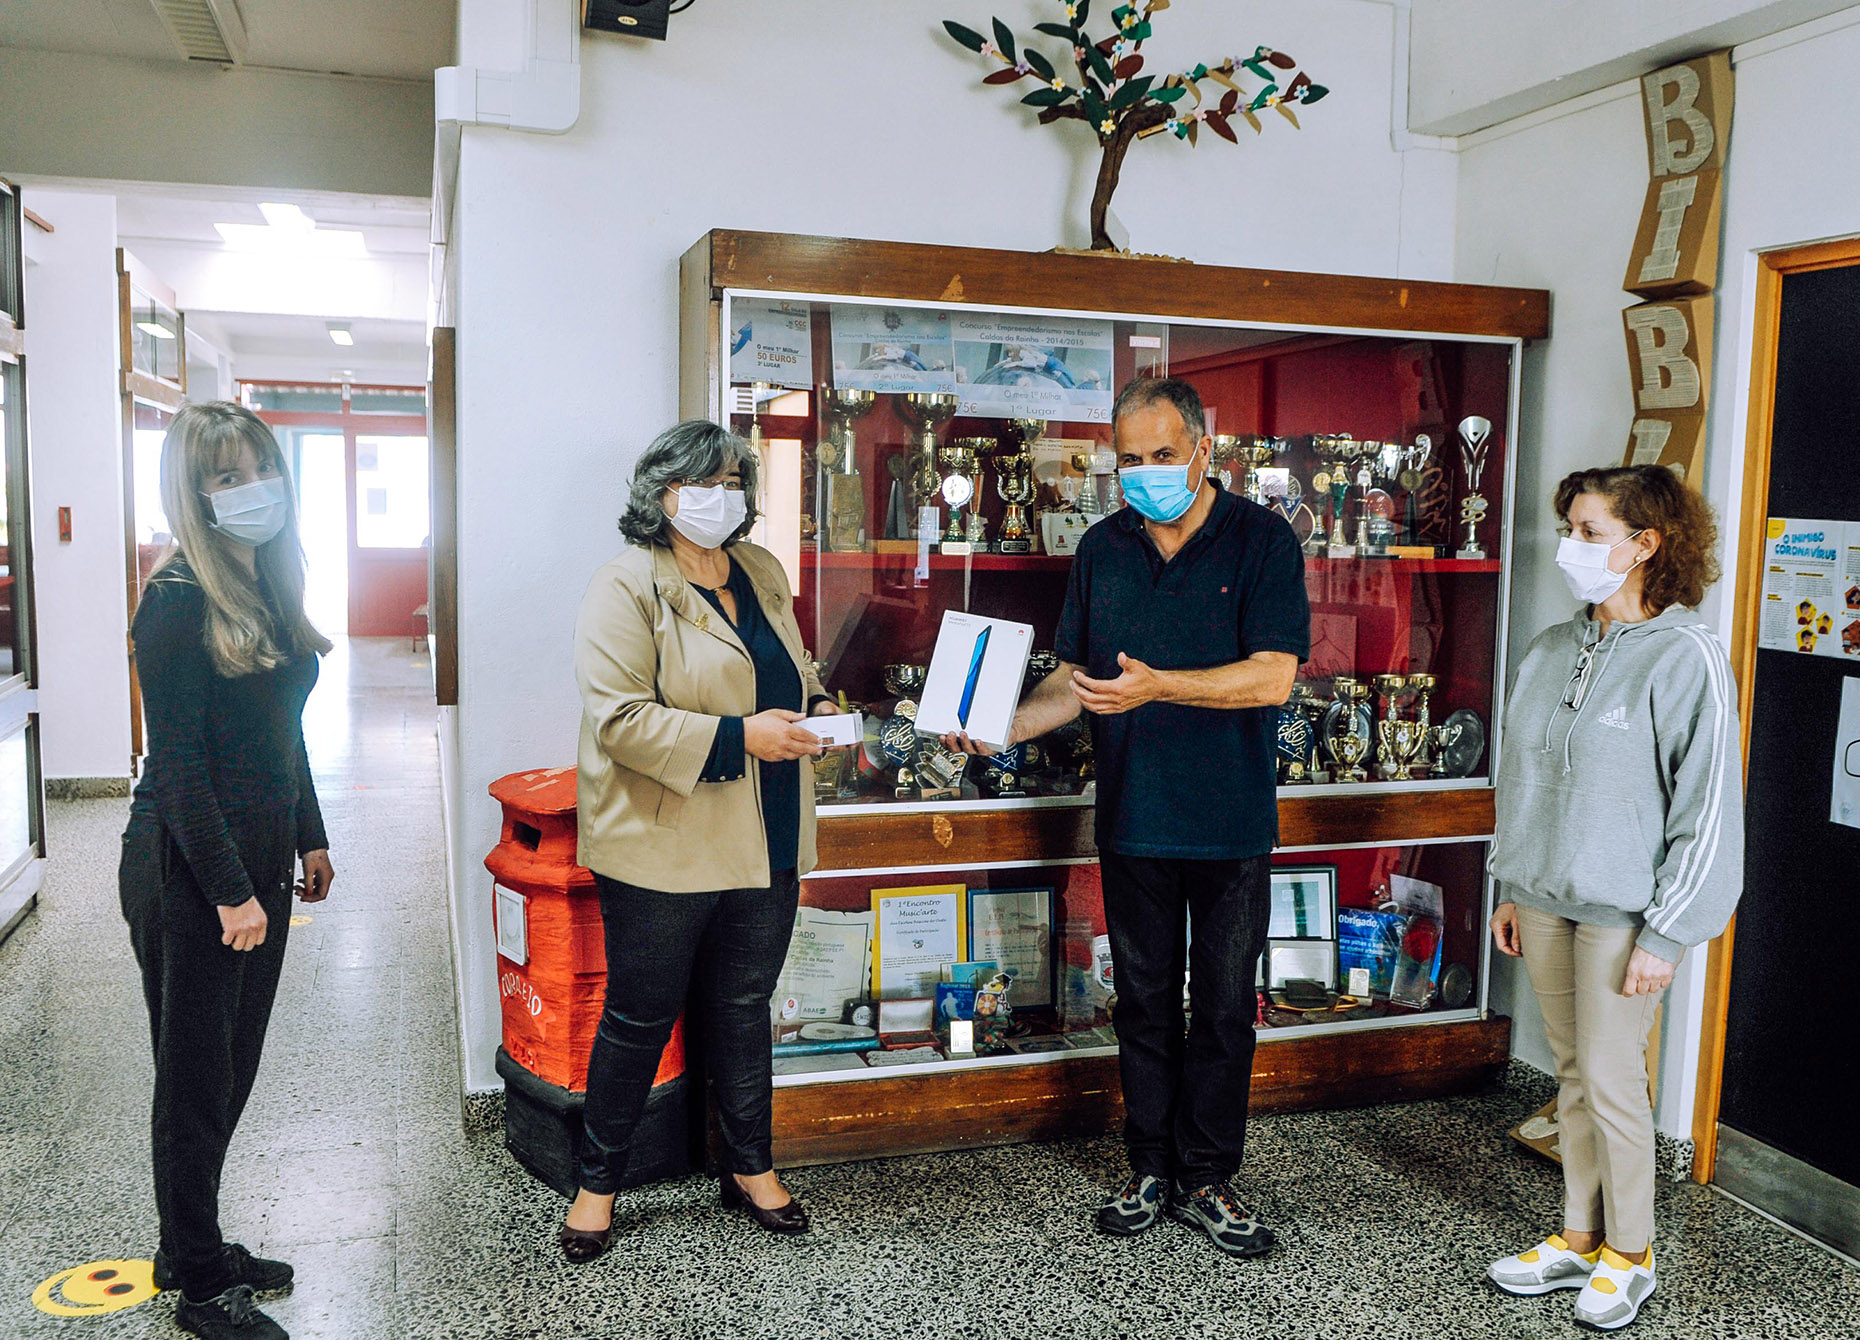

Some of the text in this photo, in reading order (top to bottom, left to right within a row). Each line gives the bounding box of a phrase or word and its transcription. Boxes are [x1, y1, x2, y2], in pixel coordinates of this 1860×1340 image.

[959, 321, 992, 330] Concurso
[980, 333, 1004, 341] Caldas
[1005, 334, 1014, 342] da
[1016, 335, 1039, 343] Rainha
[1046, 336, 1084, 346] 2014/2015
[757, 352, 797, 364] 50 EUROS
[891, 383, 914, 391] Lugar
[937, 384, 953, 392] 75€
[1003, 390, 1011, 399] O
[956, 402, 978, 414] 75€
[1026, 405, 1057, 416] Lugar
[1087, 407, 1108, 419] 75€
[1783, 534, 1790, 544] O
[1775, 543, 1837, 561] CORONAVÍRUS
[1599, 715, 1630, 730] adidas
[1338, 914, 1380, 930] Obrigado,
